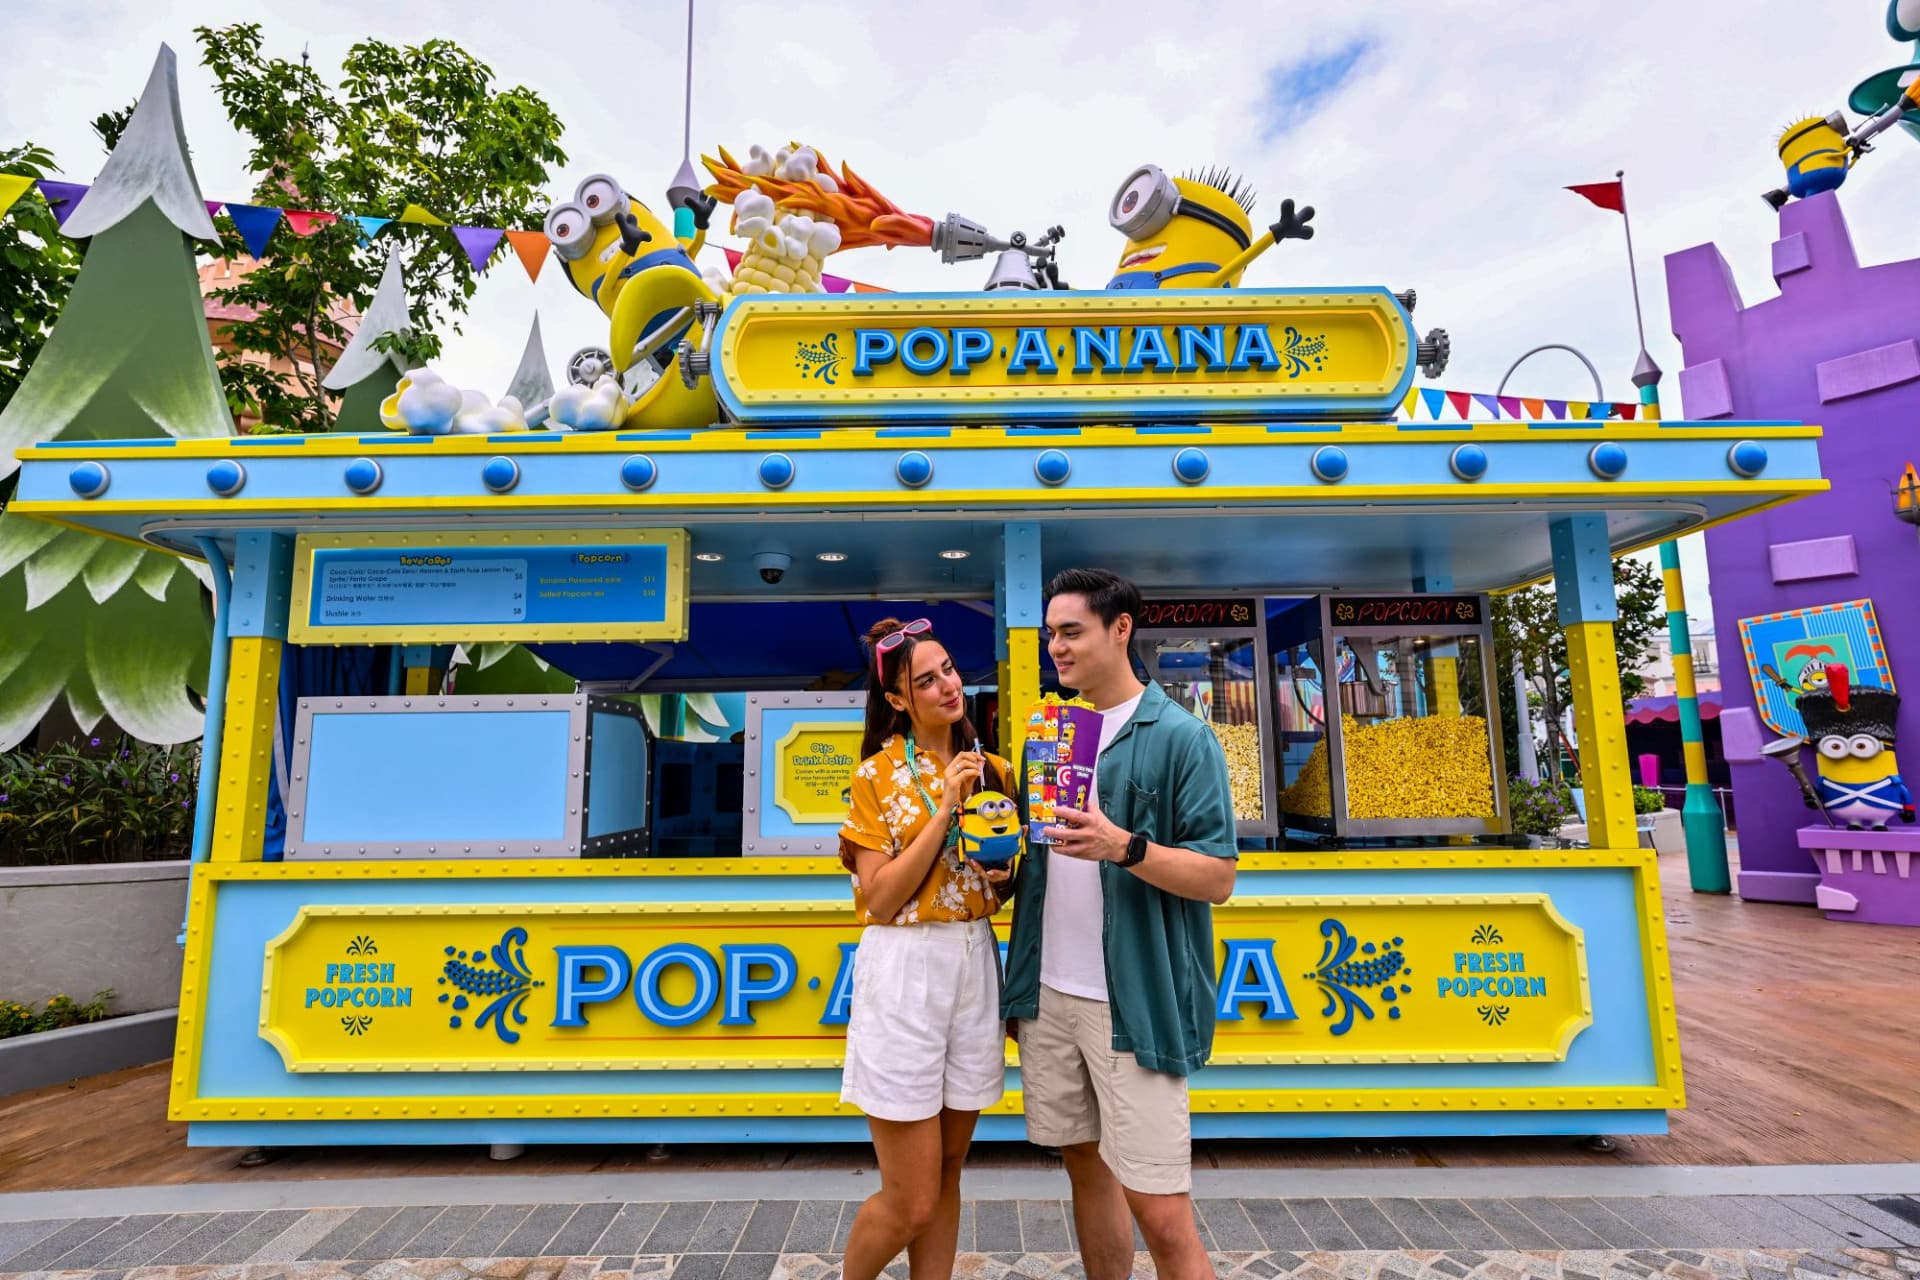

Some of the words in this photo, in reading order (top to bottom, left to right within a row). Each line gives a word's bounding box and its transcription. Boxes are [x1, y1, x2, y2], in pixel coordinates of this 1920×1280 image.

[577, 553, 623, 564] Popcorn
[1357, 601, 1453, 621] POPCORN
[326, 962, 395, 984] FRESH
[1453, 951, 1525, 973] FRESH
[1436, 975, 1547, 998] POPCORN
[305, 987, 412, 1009] POPCORN
